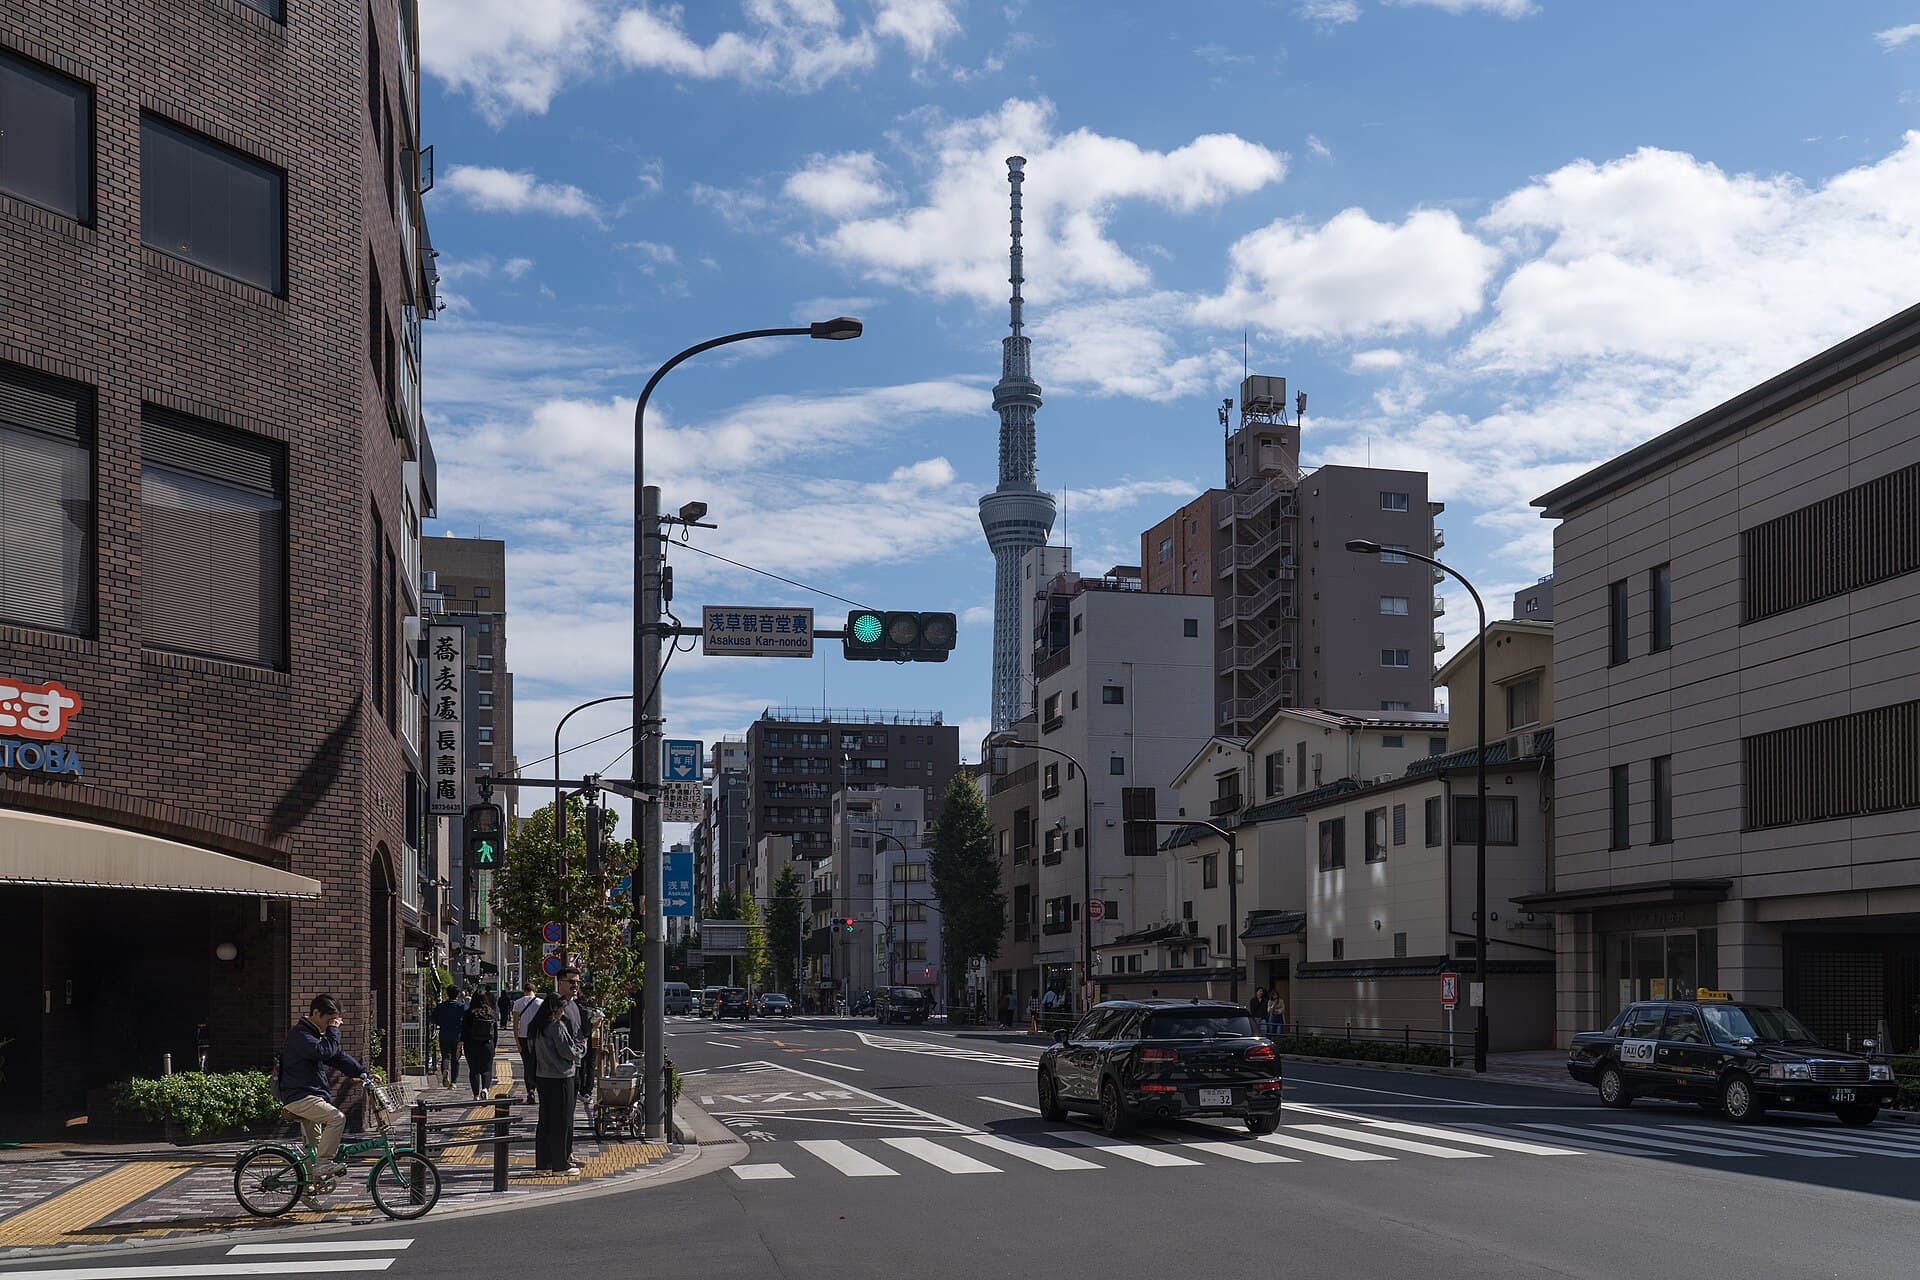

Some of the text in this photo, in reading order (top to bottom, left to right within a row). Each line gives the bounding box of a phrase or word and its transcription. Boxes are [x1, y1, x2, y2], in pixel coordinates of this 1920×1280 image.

[709, 613, 808, 634] 浅草観音堂裏
[709, 634, 808, 648] Asakusa Kan-nondo
[0, 685, 75, 733] す
[0, 739, 84, 776] TOBA
[1624, 1046, 1637, 1055] TAXI
